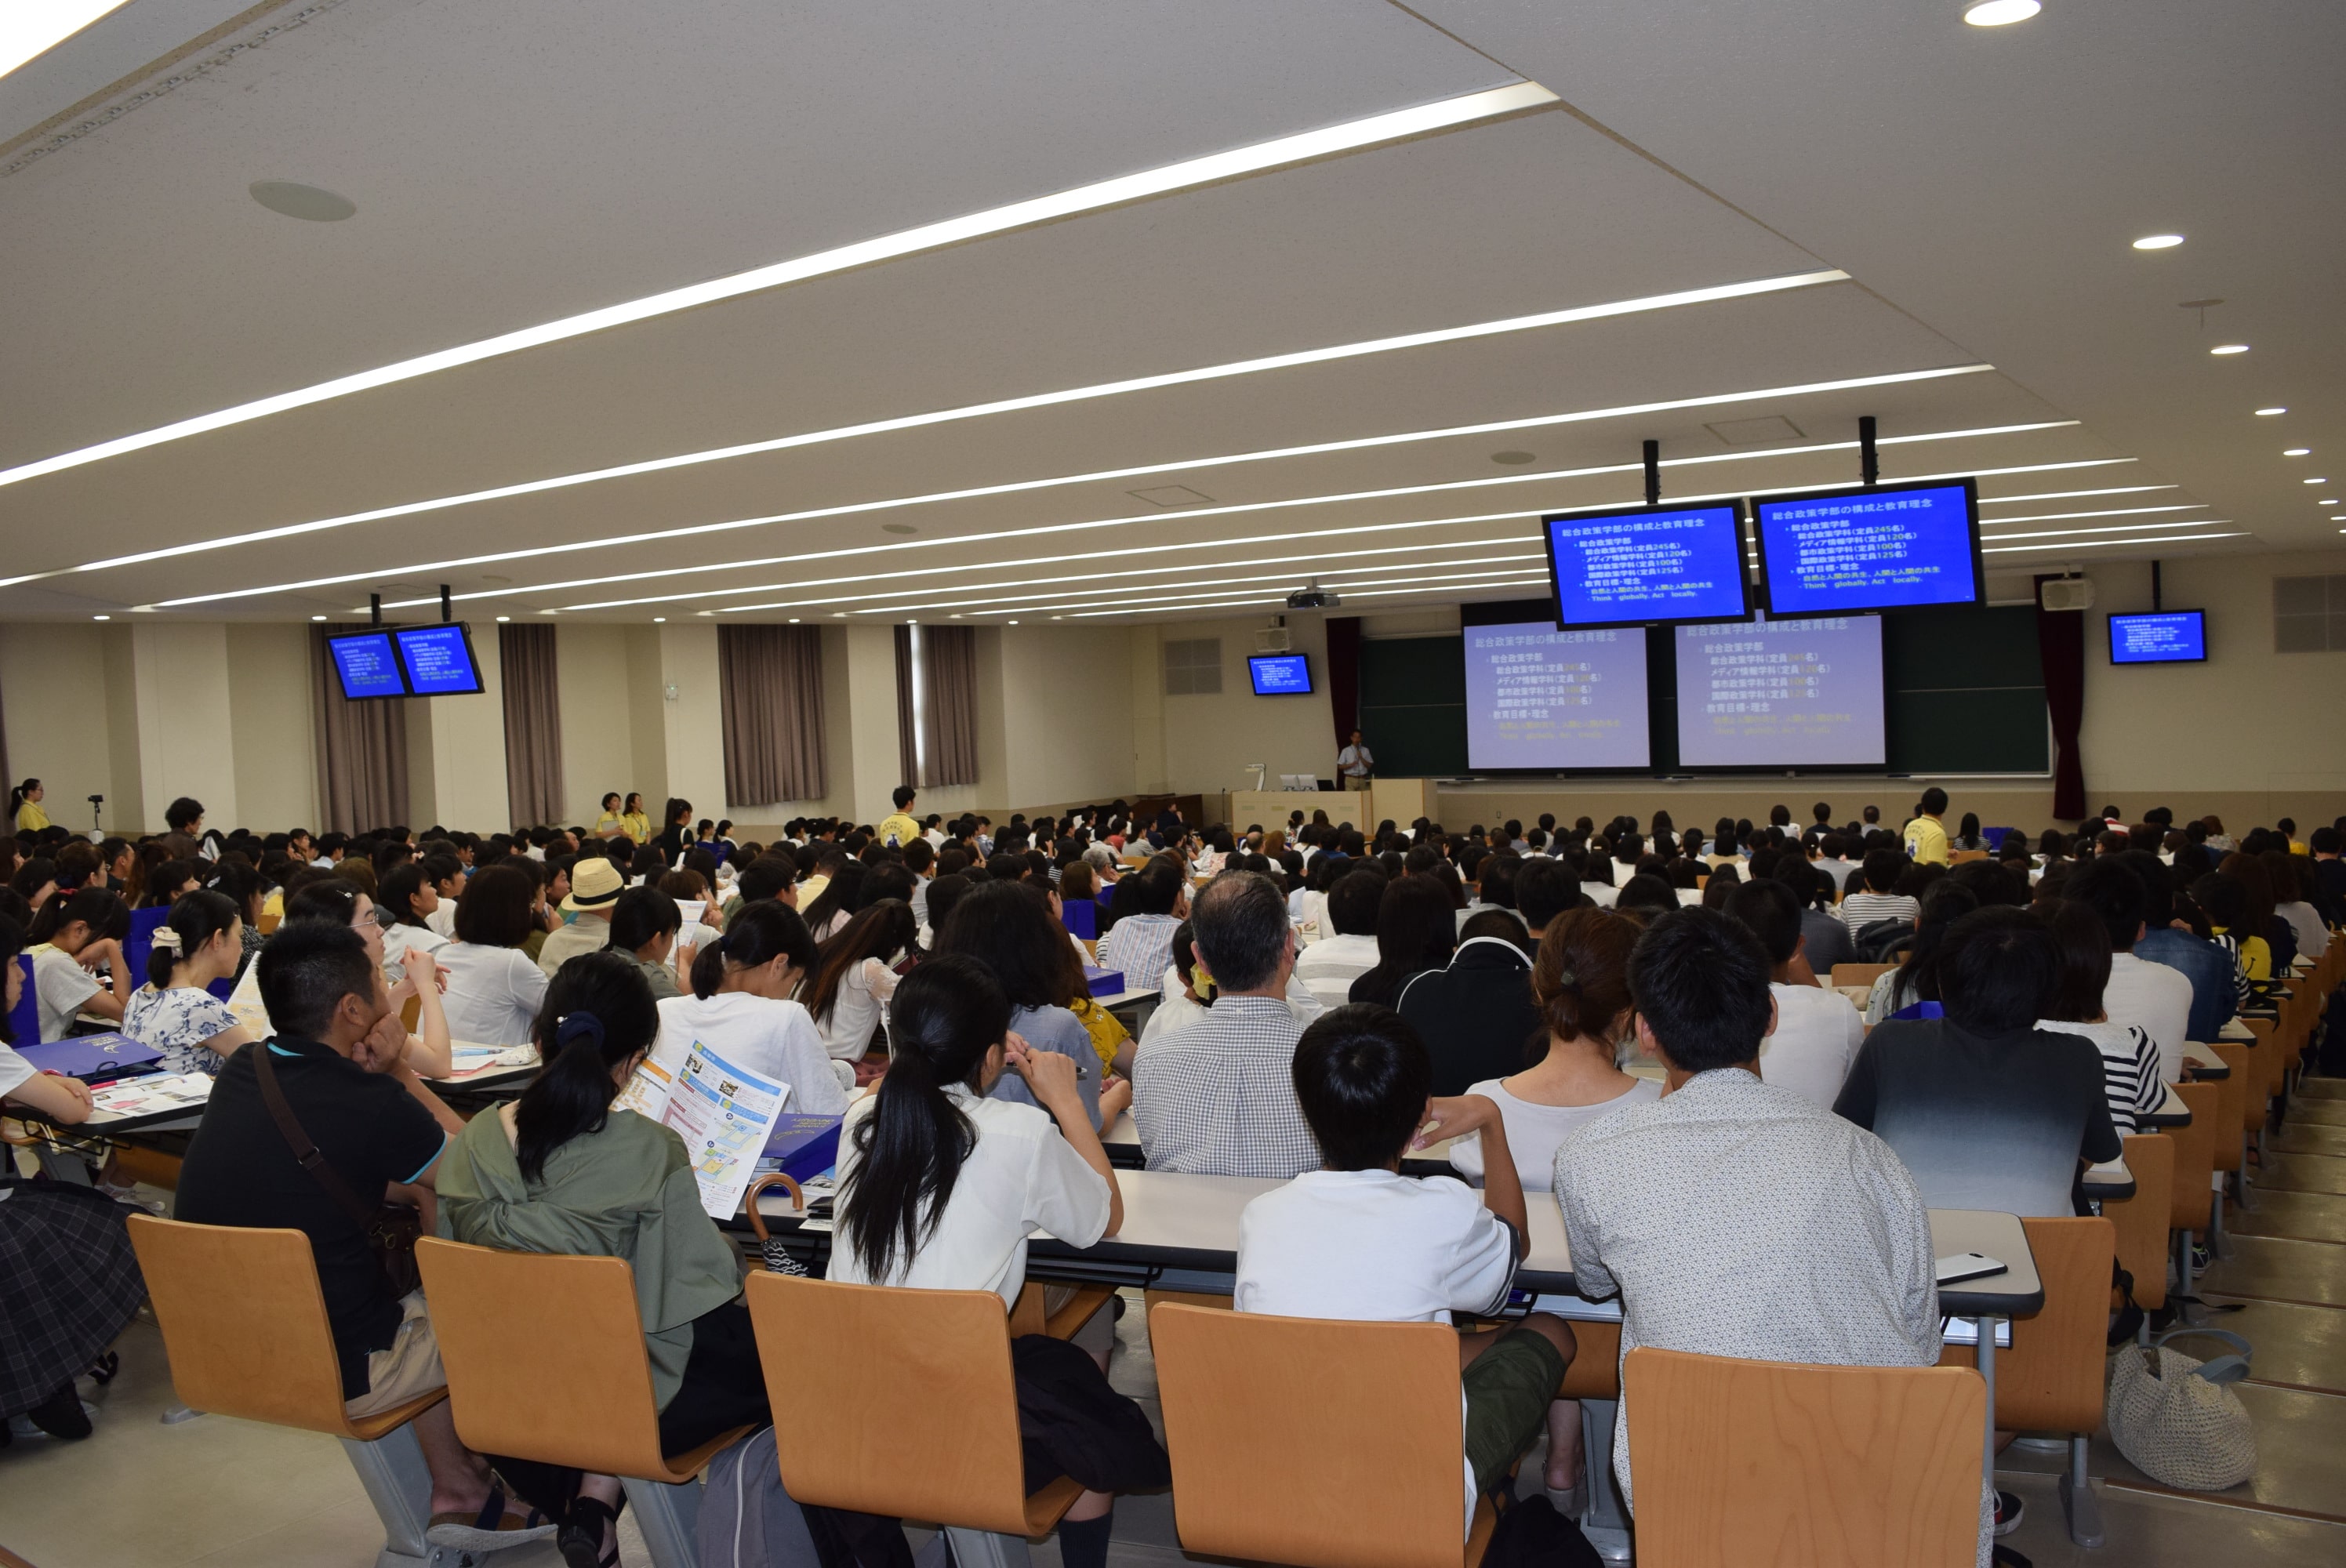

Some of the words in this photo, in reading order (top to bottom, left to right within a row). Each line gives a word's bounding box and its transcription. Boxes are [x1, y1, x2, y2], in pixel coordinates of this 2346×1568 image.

[1773, 499, 1932, 521] 総合政策学部の構成と教育理念
[1562, 518, 1705, 536] 総合政策学部の構成と教育理念
[1791, 520, 1850, 531] 総合政策学部
[1579, 537, 1631, 547] 総合政策学部
